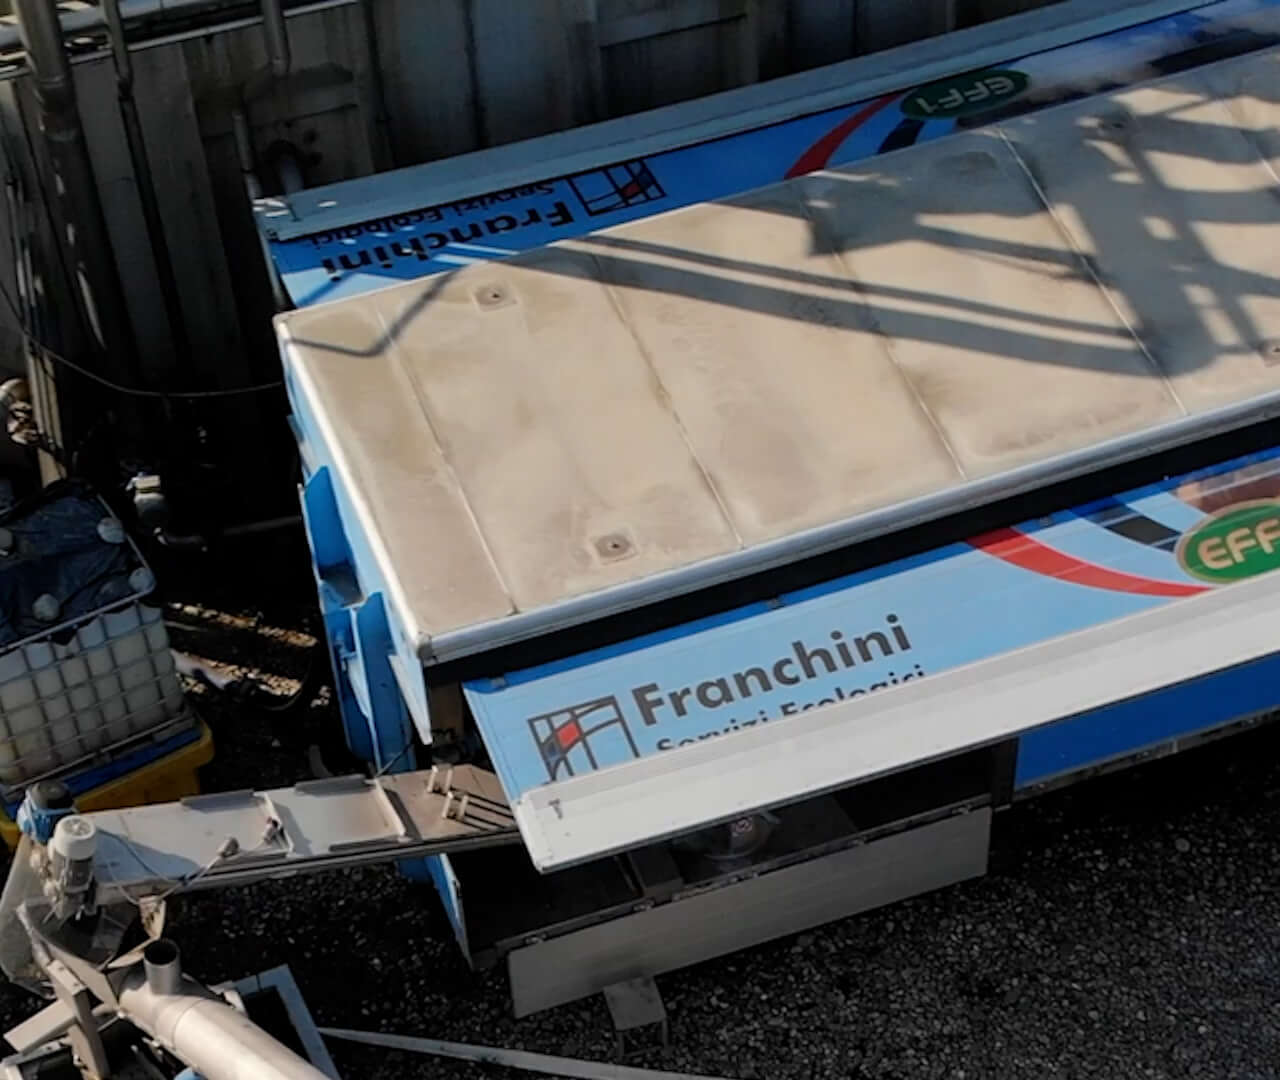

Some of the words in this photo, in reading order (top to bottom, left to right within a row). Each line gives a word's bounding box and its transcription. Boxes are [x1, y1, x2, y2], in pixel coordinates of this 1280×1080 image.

[916, 76, 1015, 114] EFF1
[322, 202, 573, 281] Franchini
[631, 614, 913, 727] Franchini
